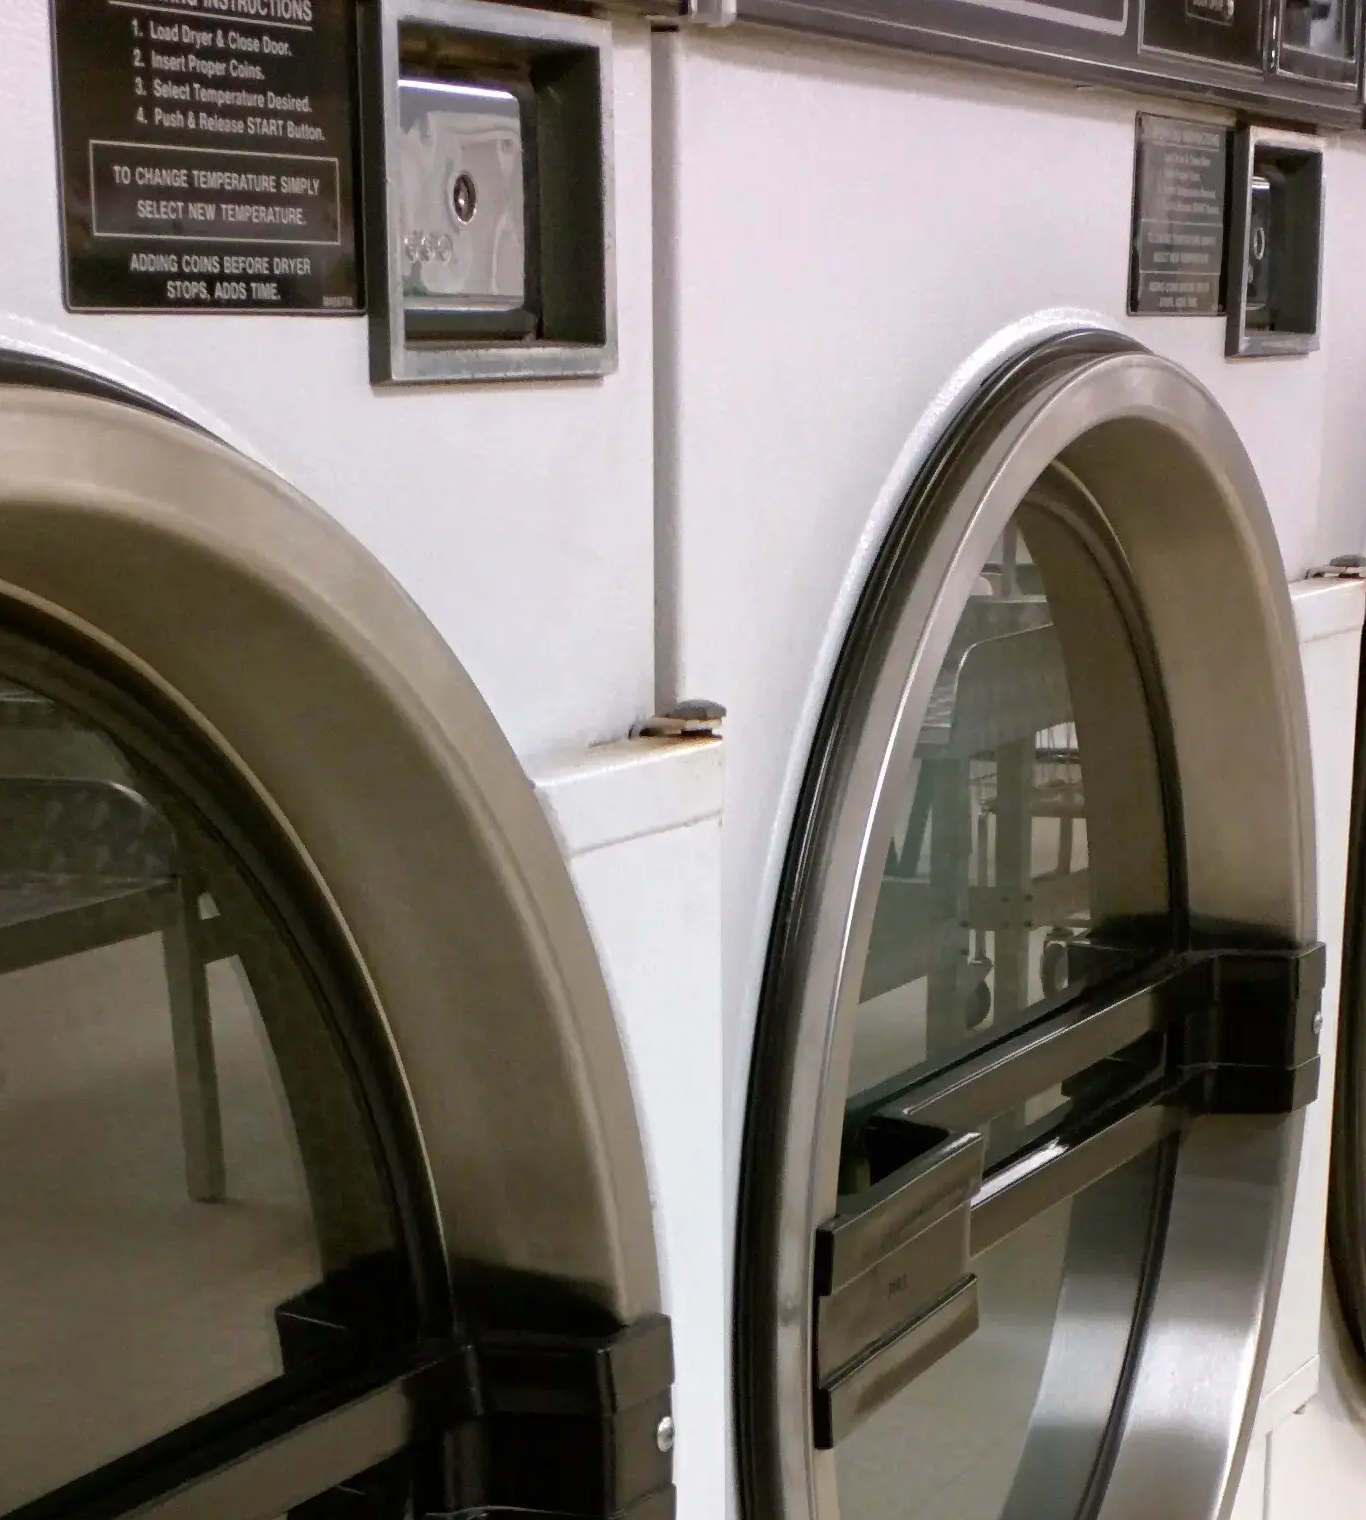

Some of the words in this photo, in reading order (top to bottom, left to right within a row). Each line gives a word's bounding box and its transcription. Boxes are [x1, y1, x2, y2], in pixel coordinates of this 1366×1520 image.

[131, 19, 143, 37] 1.
[149, 20, 179, 42] Load
[182, 24, 212, 49] Dryer
[216, 29, 225, 47] &
[228, 31, 260, 51] Close
[263, 36, 292, 56] Door.
[133, 49, 145, 67] 2.
[152, 50, 185, 72] Insert
[188, 55, 226, 78] Proper
[229, 60, 265, 80] Coins.
[134, 77, 147, 96] 3.
[153, 79, 190, 100] Select
[193, 83, 264, 107] Temperature
[267, 91, 312, 112] Desired.
[136, 107, 147, 124] 4.
[155, 107, 184, 128] Push
[188, 111, 196, 129] &
[199, 112, 244, 133] Release
[247, 117, 283, 136] START
[287, 121, 325, 140] Button.
[113, 166, 131, 184] TO
[135, 167, 188, 187] CHANGE
[191, 170, 276, 193] TEMPERATURE
[280, 176, 319, 196] SIMPLY
[137, 200, 184, 219] SELECT
[188, 203, 216, 221] NEW
[220, 204, 307, 225] TEMPERATURE.
[130, 254, 178, 271] ADDING
[182, 255, 219, 273] COINS
[224, 256, 270, 274] BEFORE
[273, 257, 311, 275] DRYER
[167, 281, 211, 301] STOPS,
[214, 282, 247, 299] ADDS
[250, 282, 281, 300] TIME.
